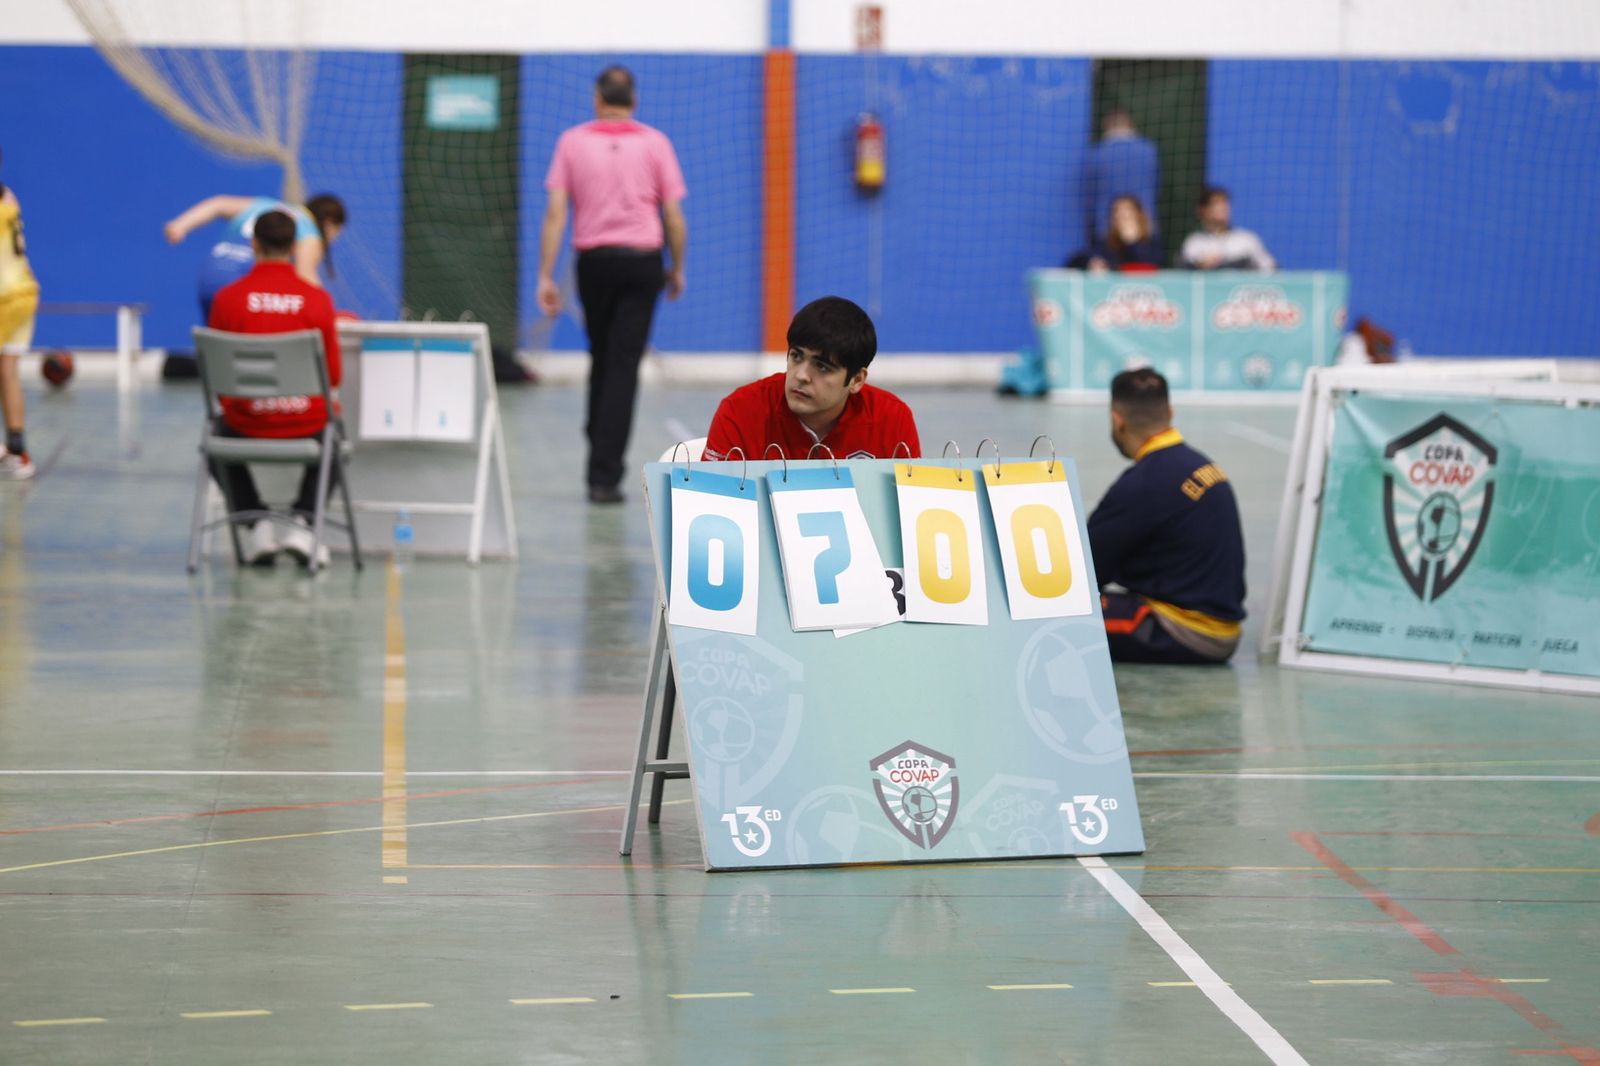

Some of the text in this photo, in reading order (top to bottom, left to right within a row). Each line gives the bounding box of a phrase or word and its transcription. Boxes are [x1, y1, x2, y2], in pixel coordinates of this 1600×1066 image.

[247, 292, 304, 314] STAFF
[1425, 444, 1464, 462] COPA
[1409, 461, 1475, 487] COVAP
[1541, 637, 1579, 655] JUEGA
[699, 647, 751, 669] COPA
[680, 662, 772, 696] COVAP
[897, 759, 929, 769] COPA
[889, 769, 940, 783] COVAP
[985, 800, 1045, 831] COVAP
